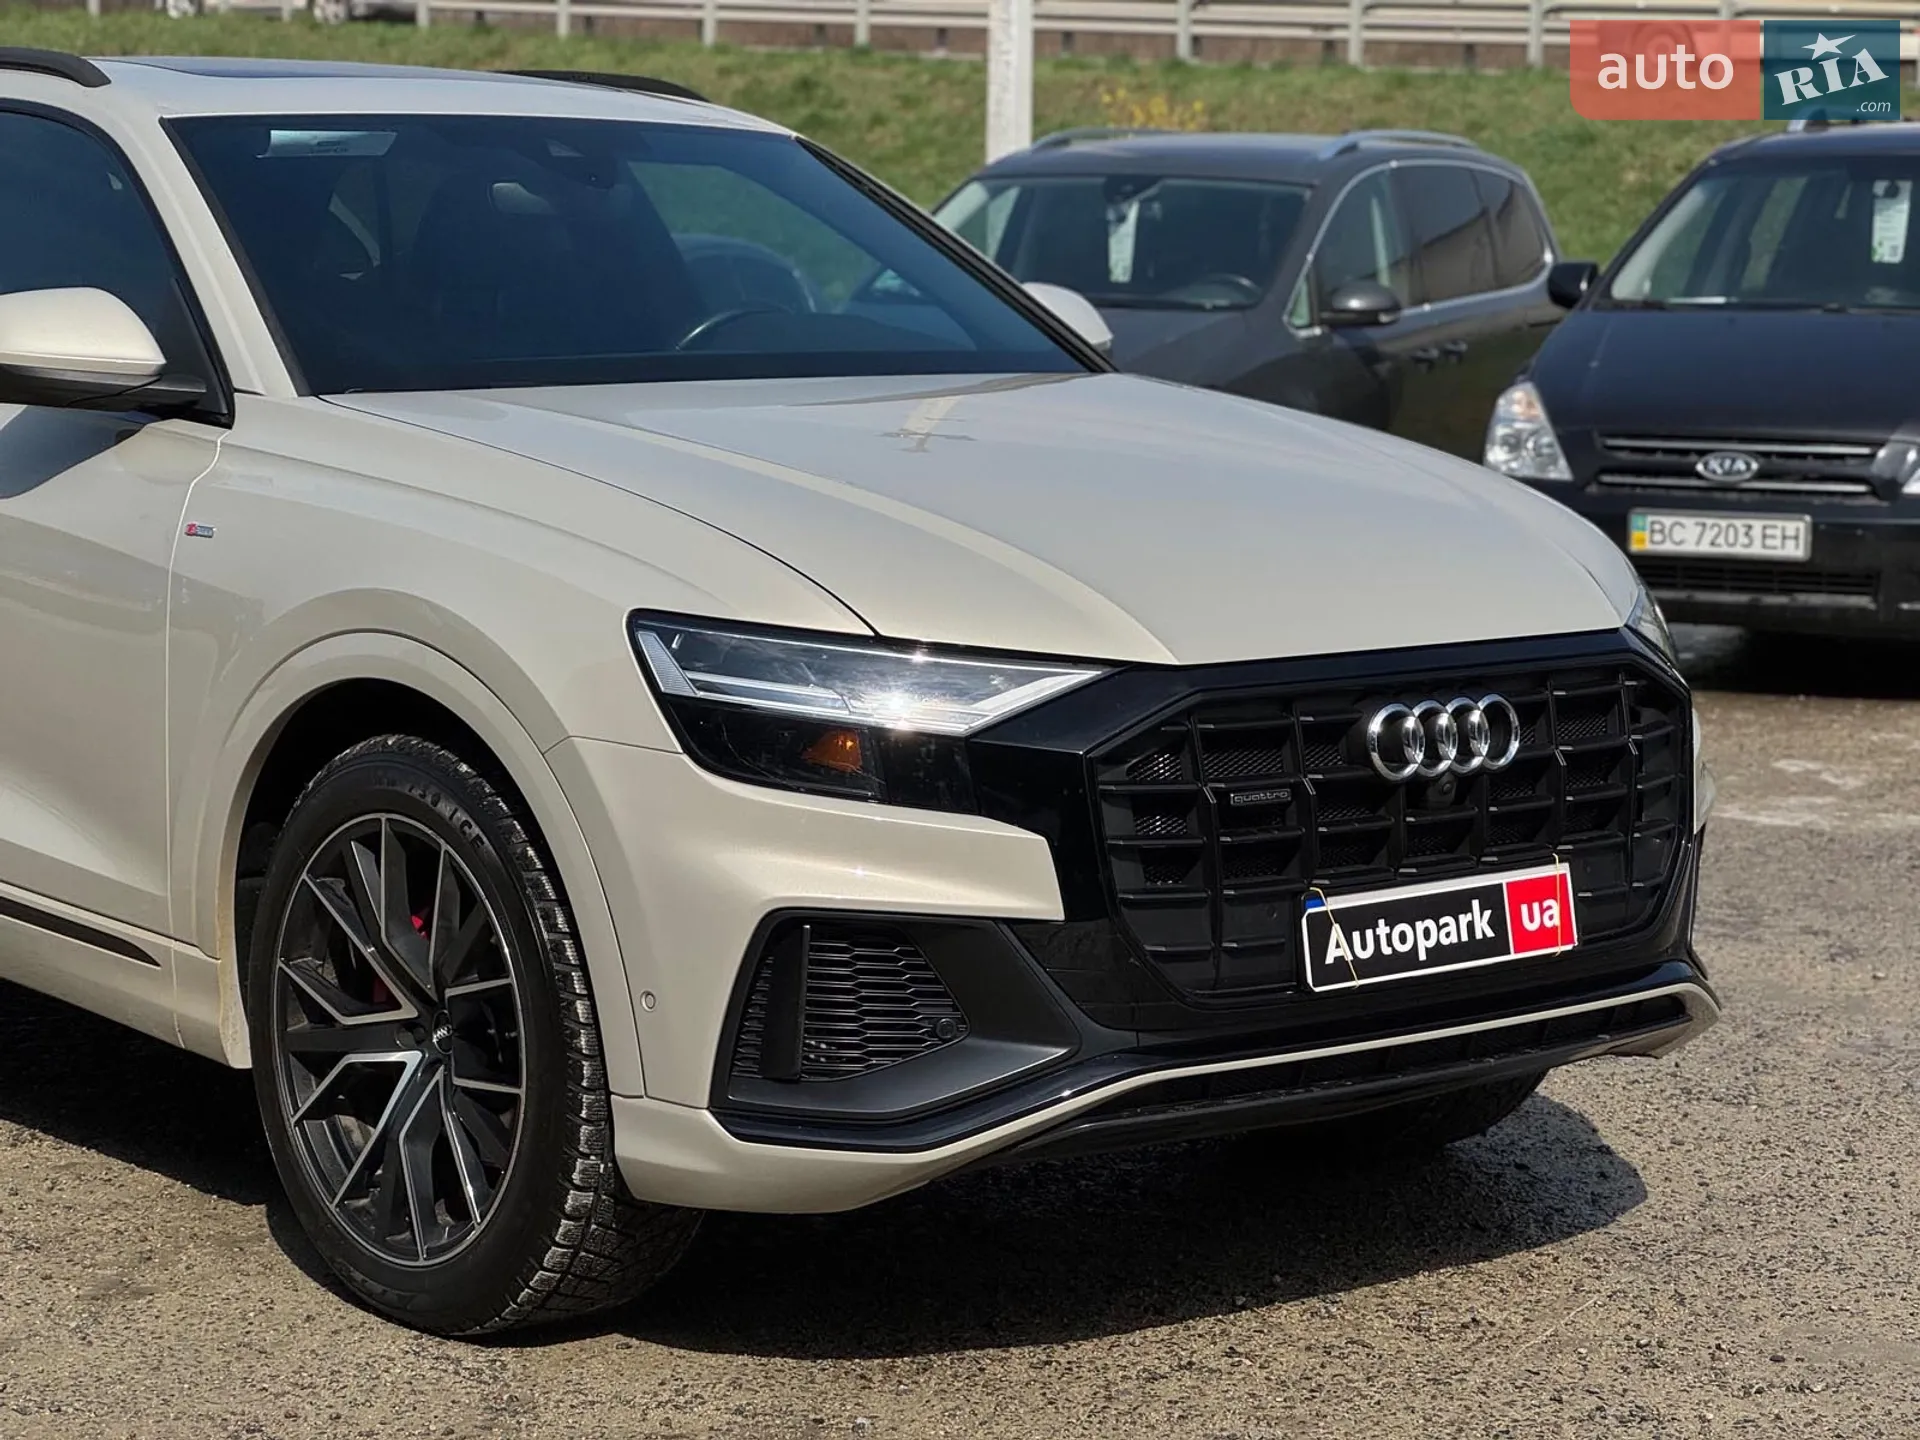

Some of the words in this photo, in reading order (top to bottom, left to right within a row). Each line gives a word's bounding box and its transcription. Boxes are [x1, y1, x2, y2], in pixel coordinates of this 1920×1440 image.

[1707, 457, 1748, 476] KIA
[1650, 520, 1686, 547] BC
[1694, 521, 1754, 549] 7203
[1761, 524, 1800, 551] EH
[1234, 791, 1288, 804] quattro
[1324, 898, 1496, 965] Autopark
[1519, 898, 1559, 932] ua
